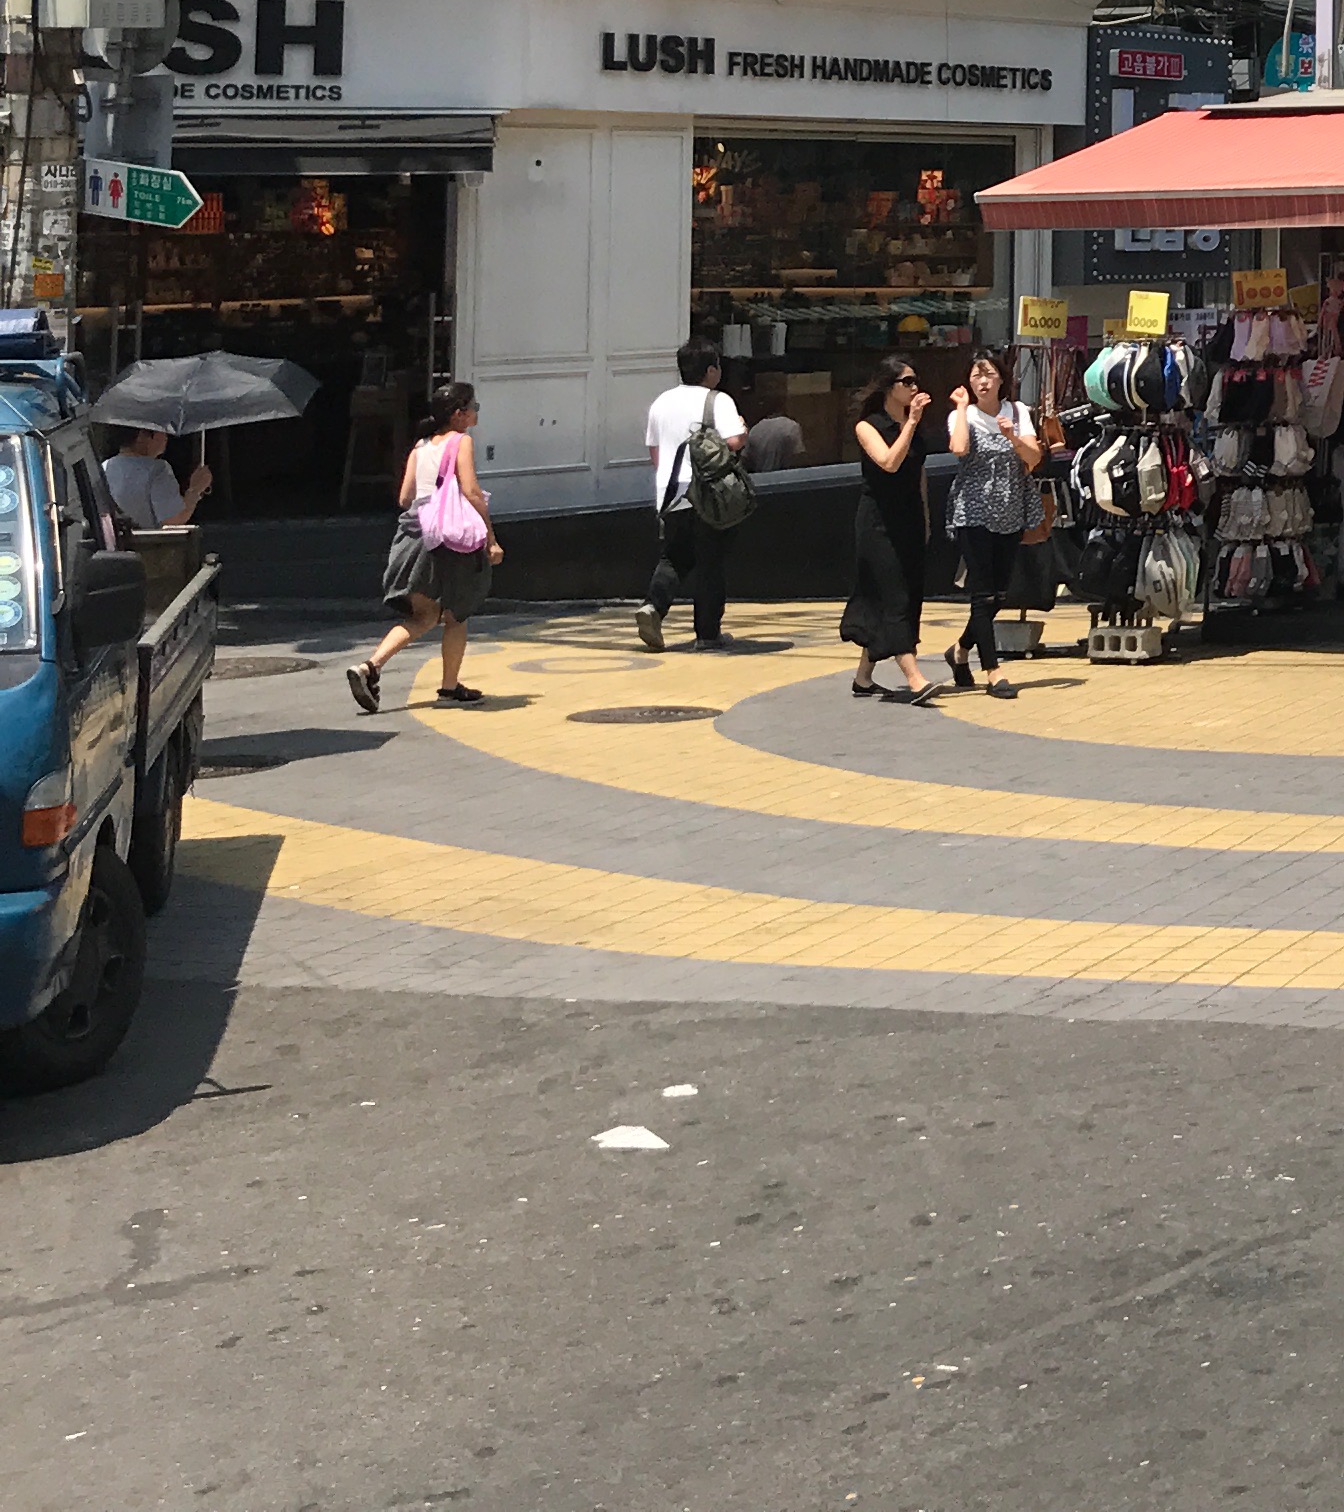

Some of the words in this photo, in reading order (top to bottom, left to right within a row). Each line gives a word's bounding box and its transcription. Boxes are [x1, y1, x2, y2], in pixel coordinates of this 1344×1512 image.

[601, 30, 716, 76] LUSH
[727, 51, 805, 81] FRESH
[811, 56, 934, 87] HANDMADE
[936, 61, 1053, 92] COSMETICS
[204, 82, 343, 102] COSMETICS
